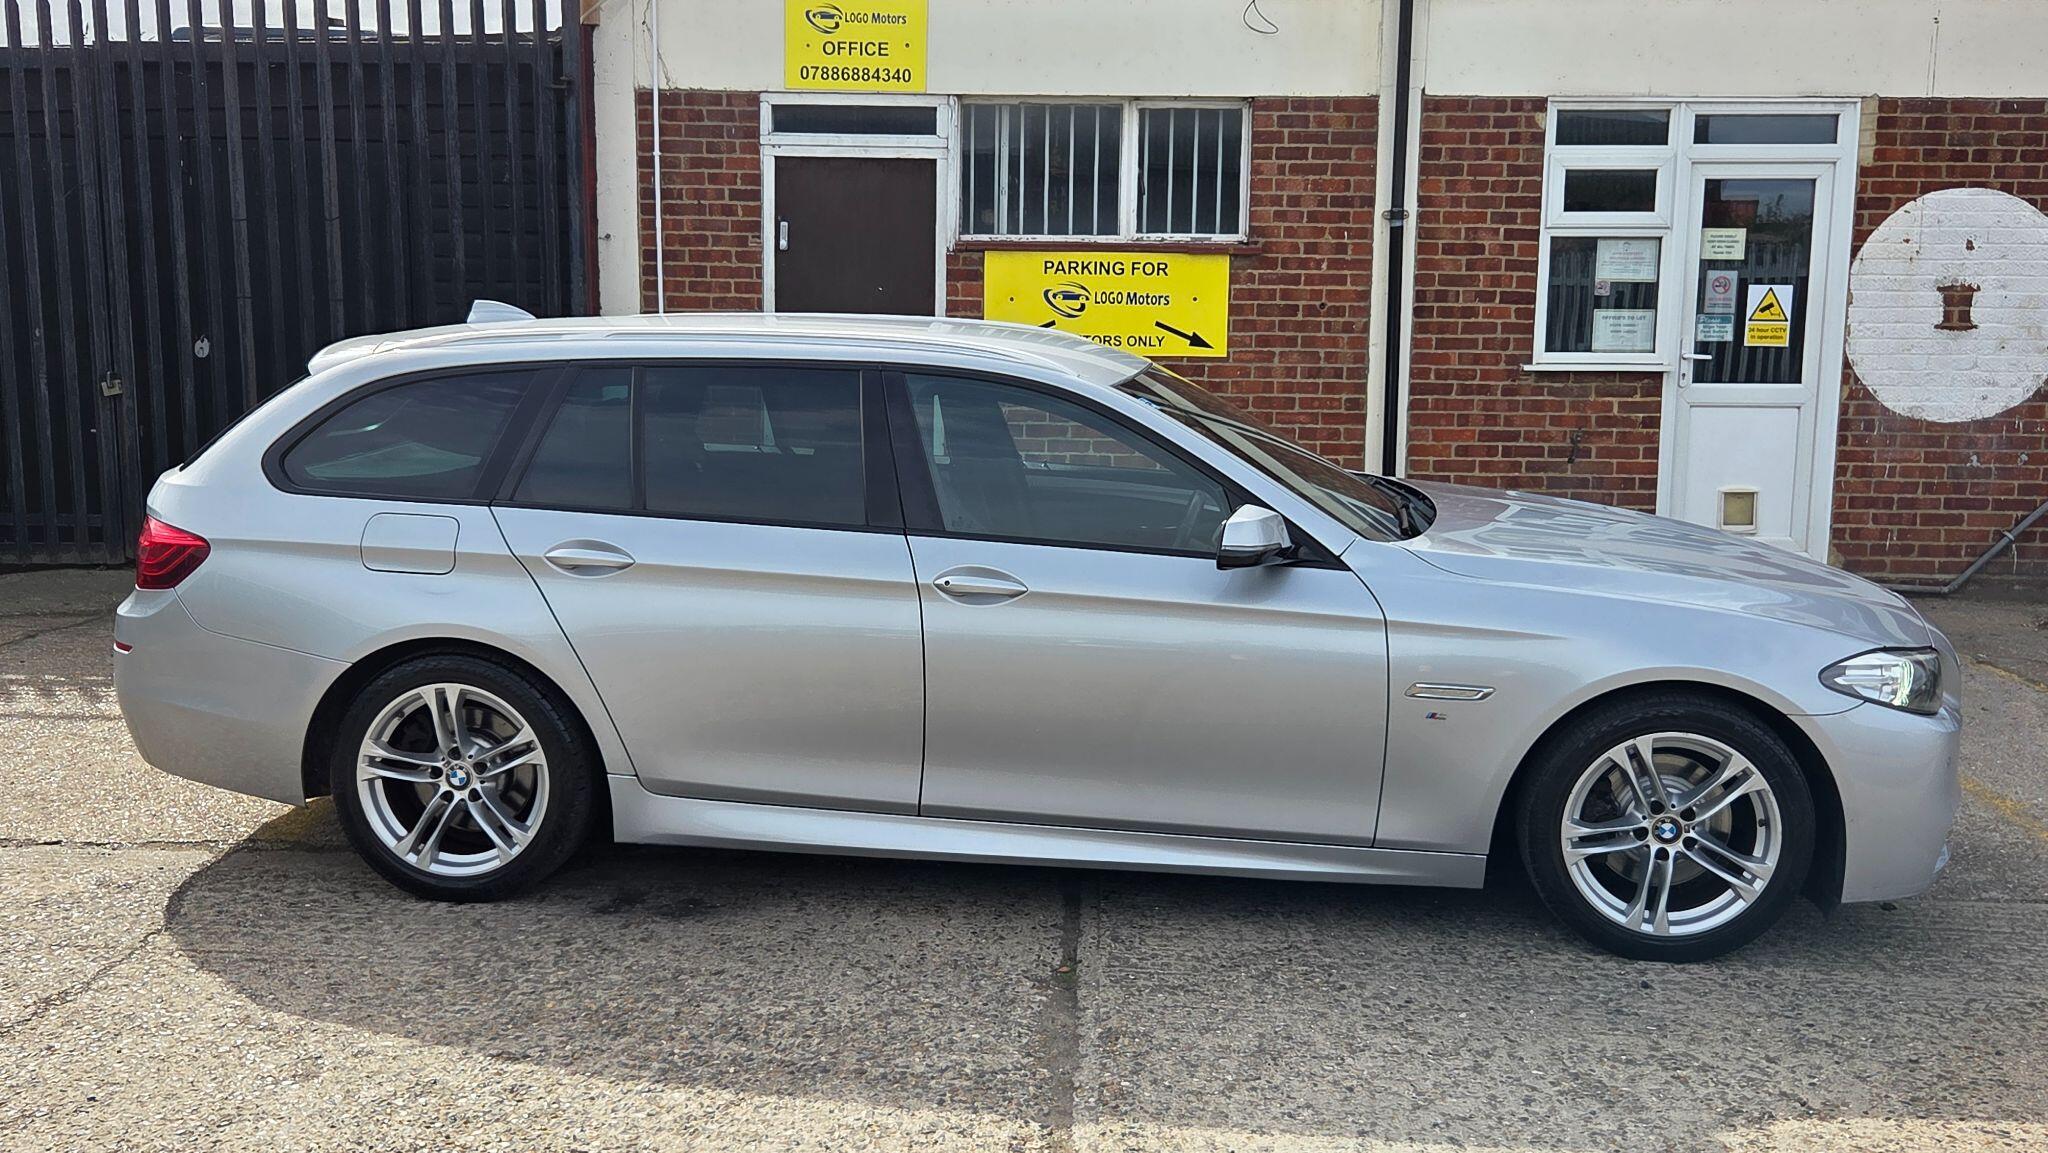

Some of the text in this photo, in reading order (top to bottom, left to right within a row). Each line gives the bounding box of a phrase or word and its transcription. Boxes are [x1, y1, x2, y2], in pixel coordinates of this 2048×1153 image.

[845, 12, 907, 25] LOGO Motors
[822, 40, 889, 57] OFFICE
[800, 65, 912, 83] 07886884340
[1043, 260, 1169, 276] PARKING FOR
[1093, 291, 1170, 306] LOGO Motors
[1126, 335, 1166, 347] ONLY
